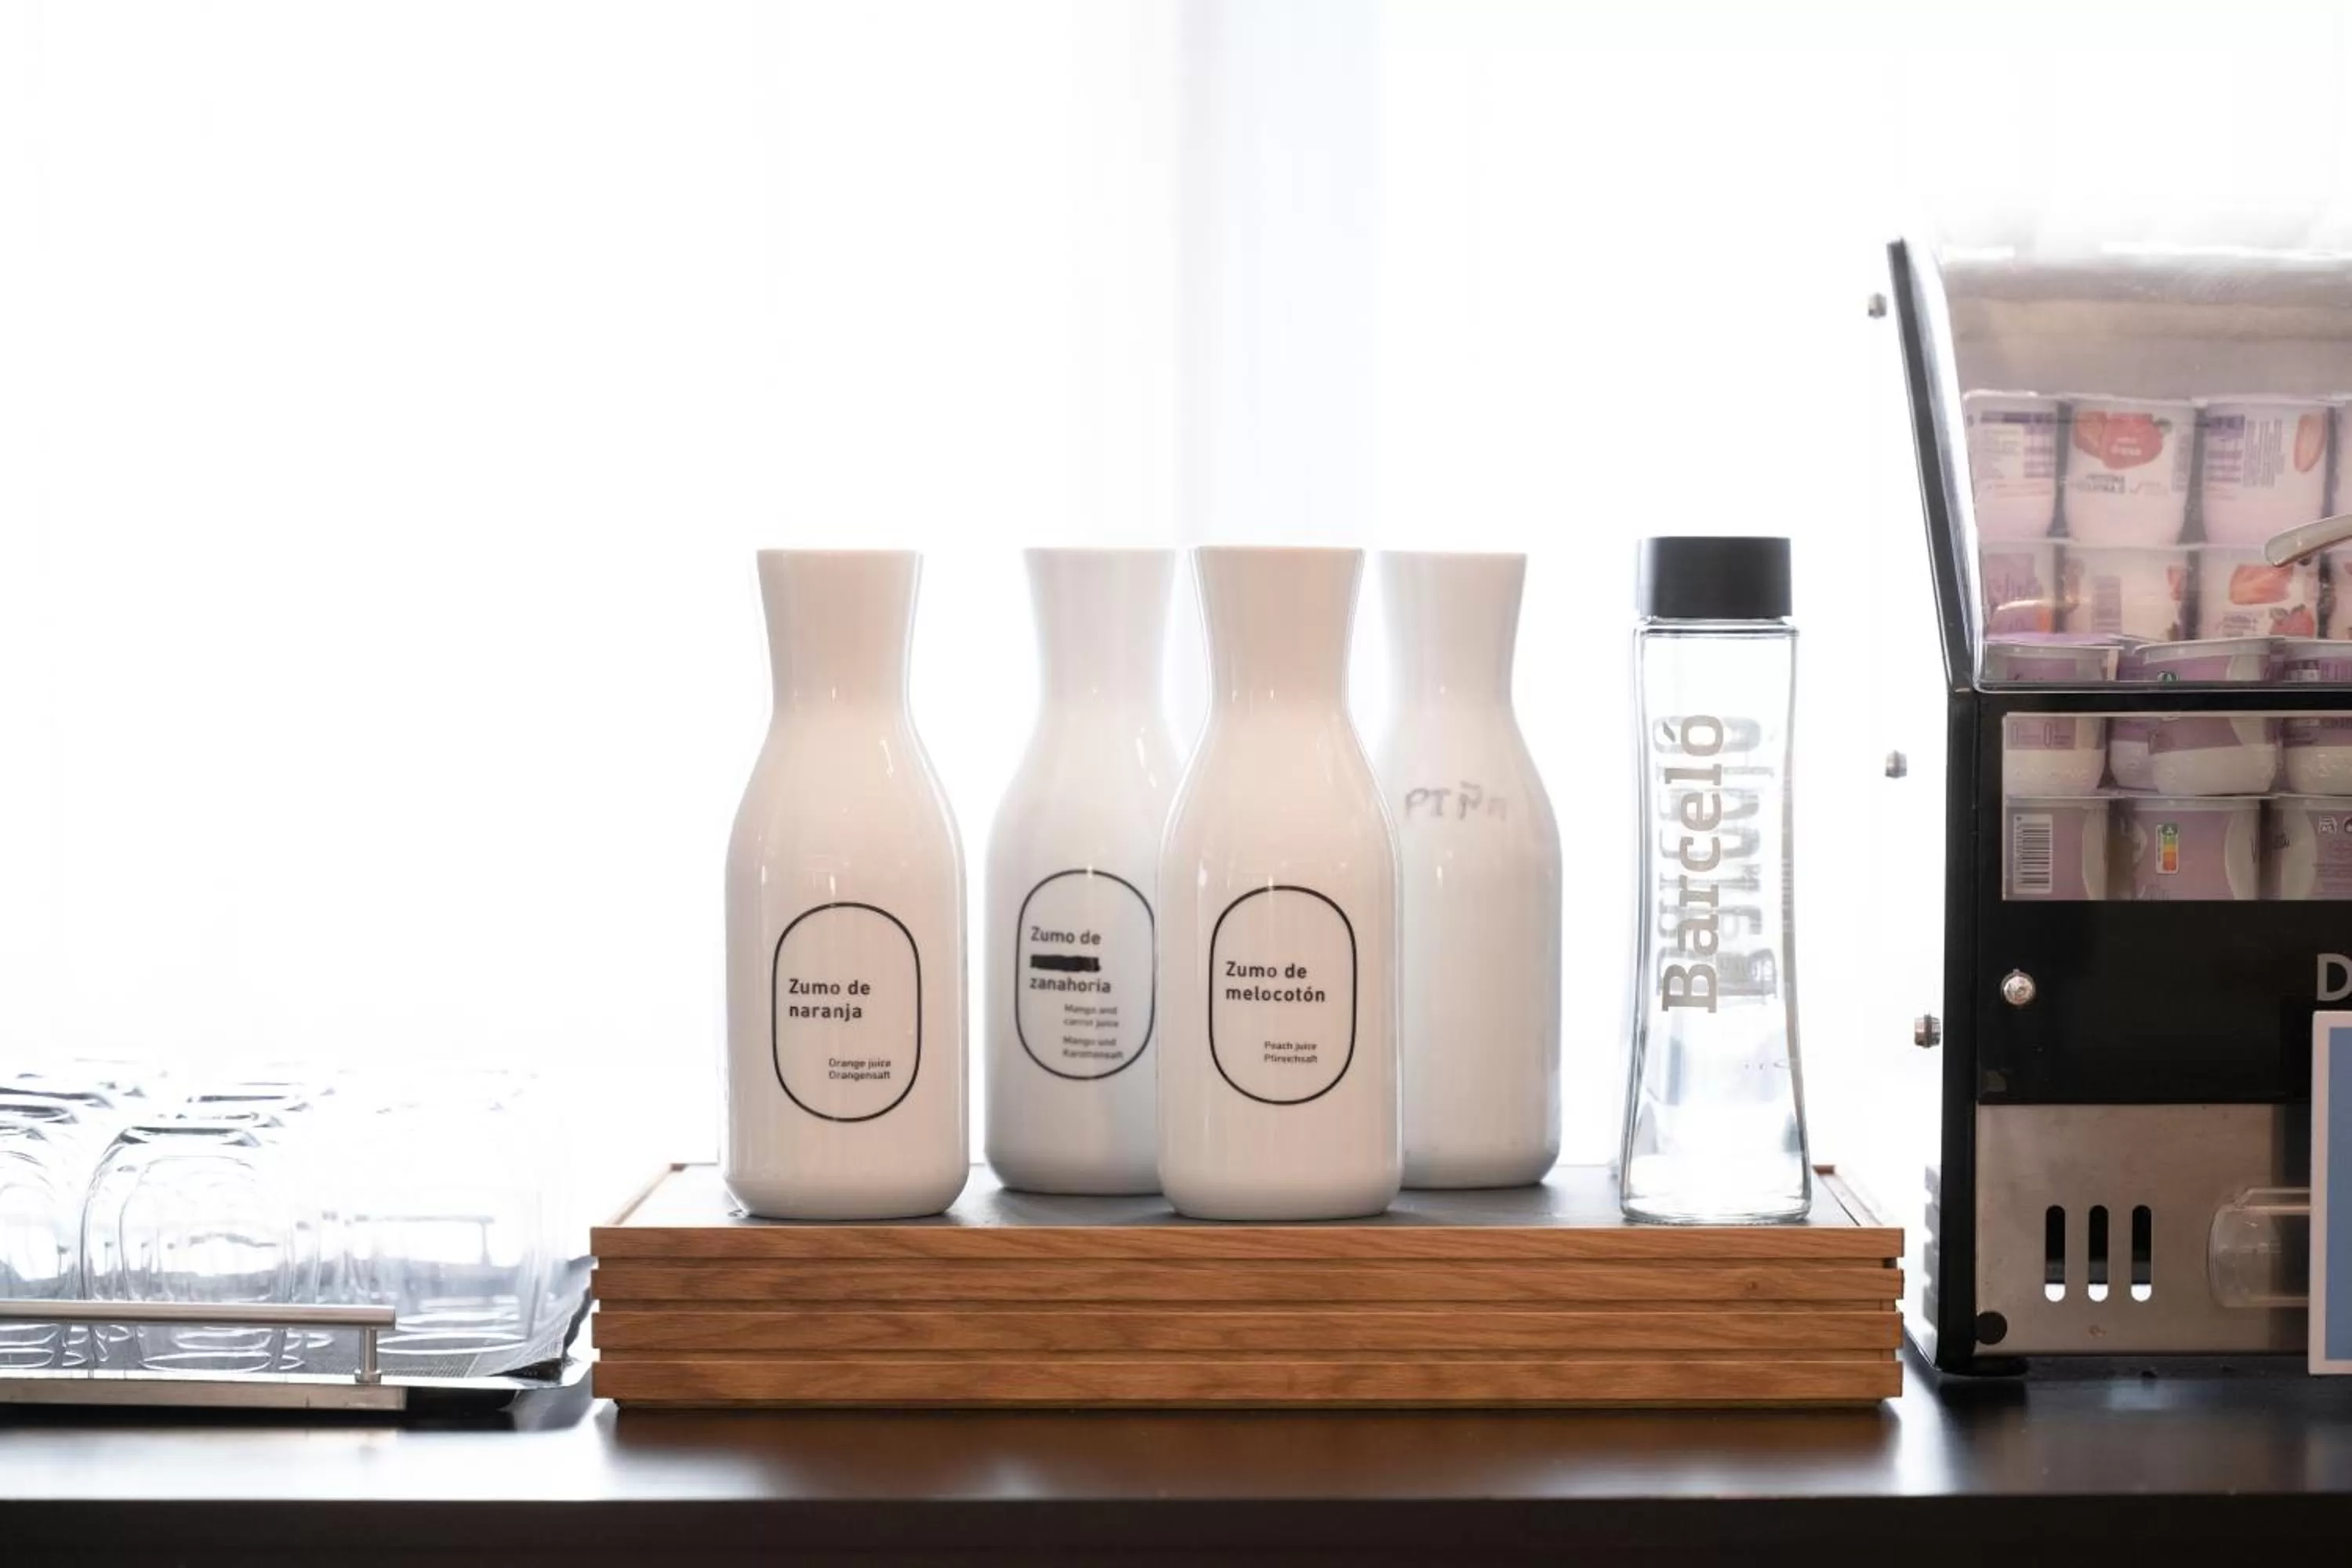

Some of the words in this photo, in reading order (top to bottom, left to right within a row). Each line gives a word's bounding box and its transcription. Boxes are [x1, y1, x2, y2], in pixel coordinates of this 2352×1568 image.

[1661, 714, 1725, 1013] Barceló
[1029, 925, 1076, 945] Zumo
[1079, 928, 1102, 946] de
[1225, 960, 1278, 978] Zumo
[1284, 962, 1308, 979] de
[788, 978, 841, 996] Zumo
[847, 979, 871, 996] de
[1029, 975, 1112, 994] zanahoria
[1225, 985, 1327, 1003] melocotón
[789, 1003, 863, 1022] naranja
[1264, 1040, 1294, 1051] Peach
[1294, 1041, 1318, 1052] juice
[828, 1058, 866, 1069] Orange
[867, 1057, 892, 1069] juice
[828, 1069, 891, 1082] Orangensaft
